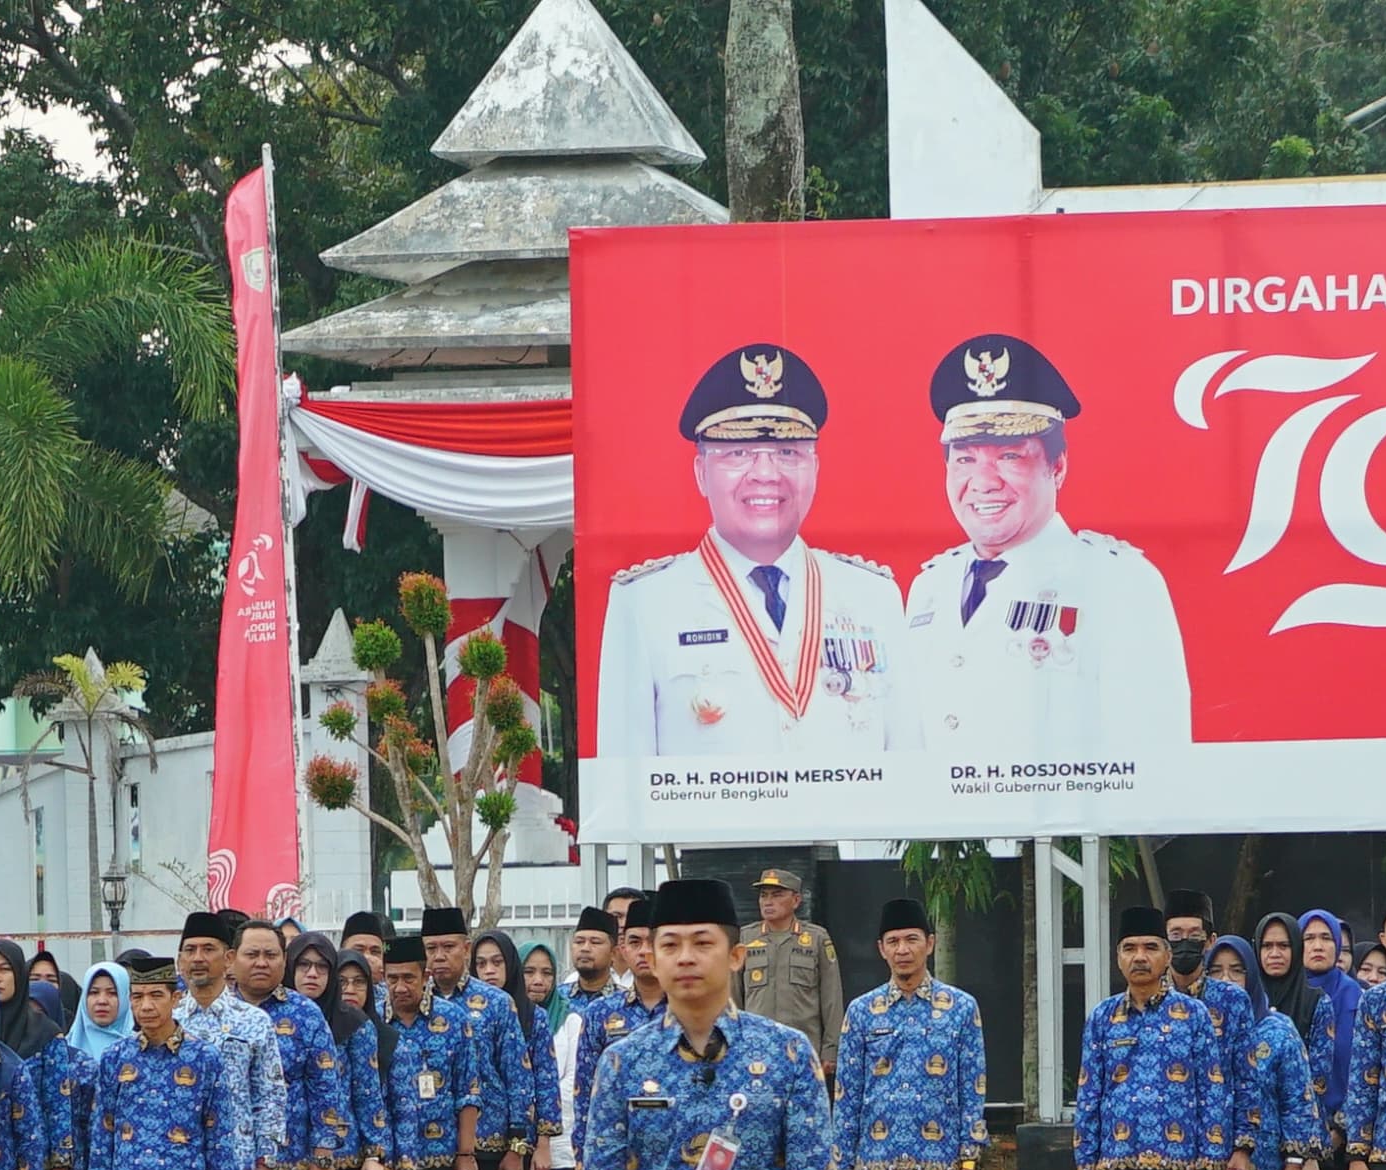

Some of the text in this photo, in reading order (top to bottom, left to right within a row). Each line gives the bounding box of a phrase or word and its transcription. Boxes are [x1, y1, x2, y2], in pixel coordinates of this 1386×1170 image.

[650, 768, 883, 786] DR. H. ROHIDIN MERSYAH
[950, 762, 1135, 779] DR. H. ROSJONSYAH
[650, 787, 789, 801] Gubernur Bengkulu
[951, 779, 1134, 794] Wakil Gubernur Bengkulu
